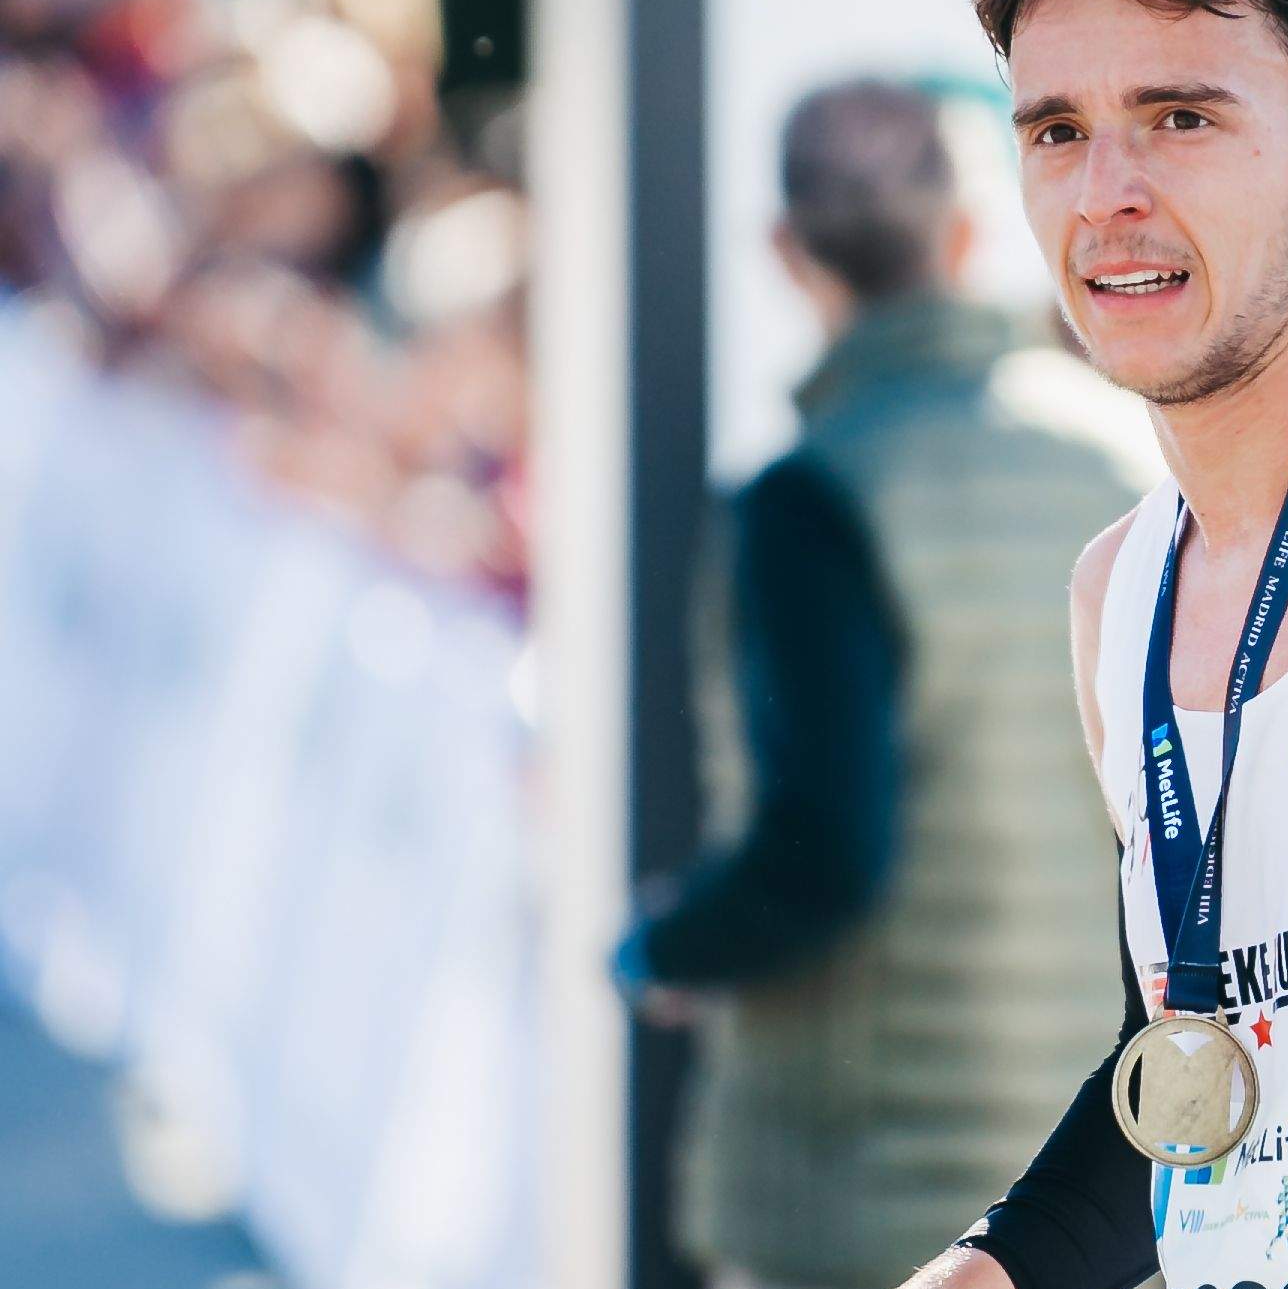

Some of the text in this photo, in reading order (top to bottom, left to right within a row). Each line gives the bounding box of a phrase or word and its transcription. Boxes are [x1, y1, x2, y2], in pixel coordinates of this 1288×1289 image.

[1247, 575, 1280, 647] MADRID
[1229, 652, 1251, 714] ACTIVA
[1156, 758, 1183, 840] MetLife
[1197, 895, 1211, 925] VIII
